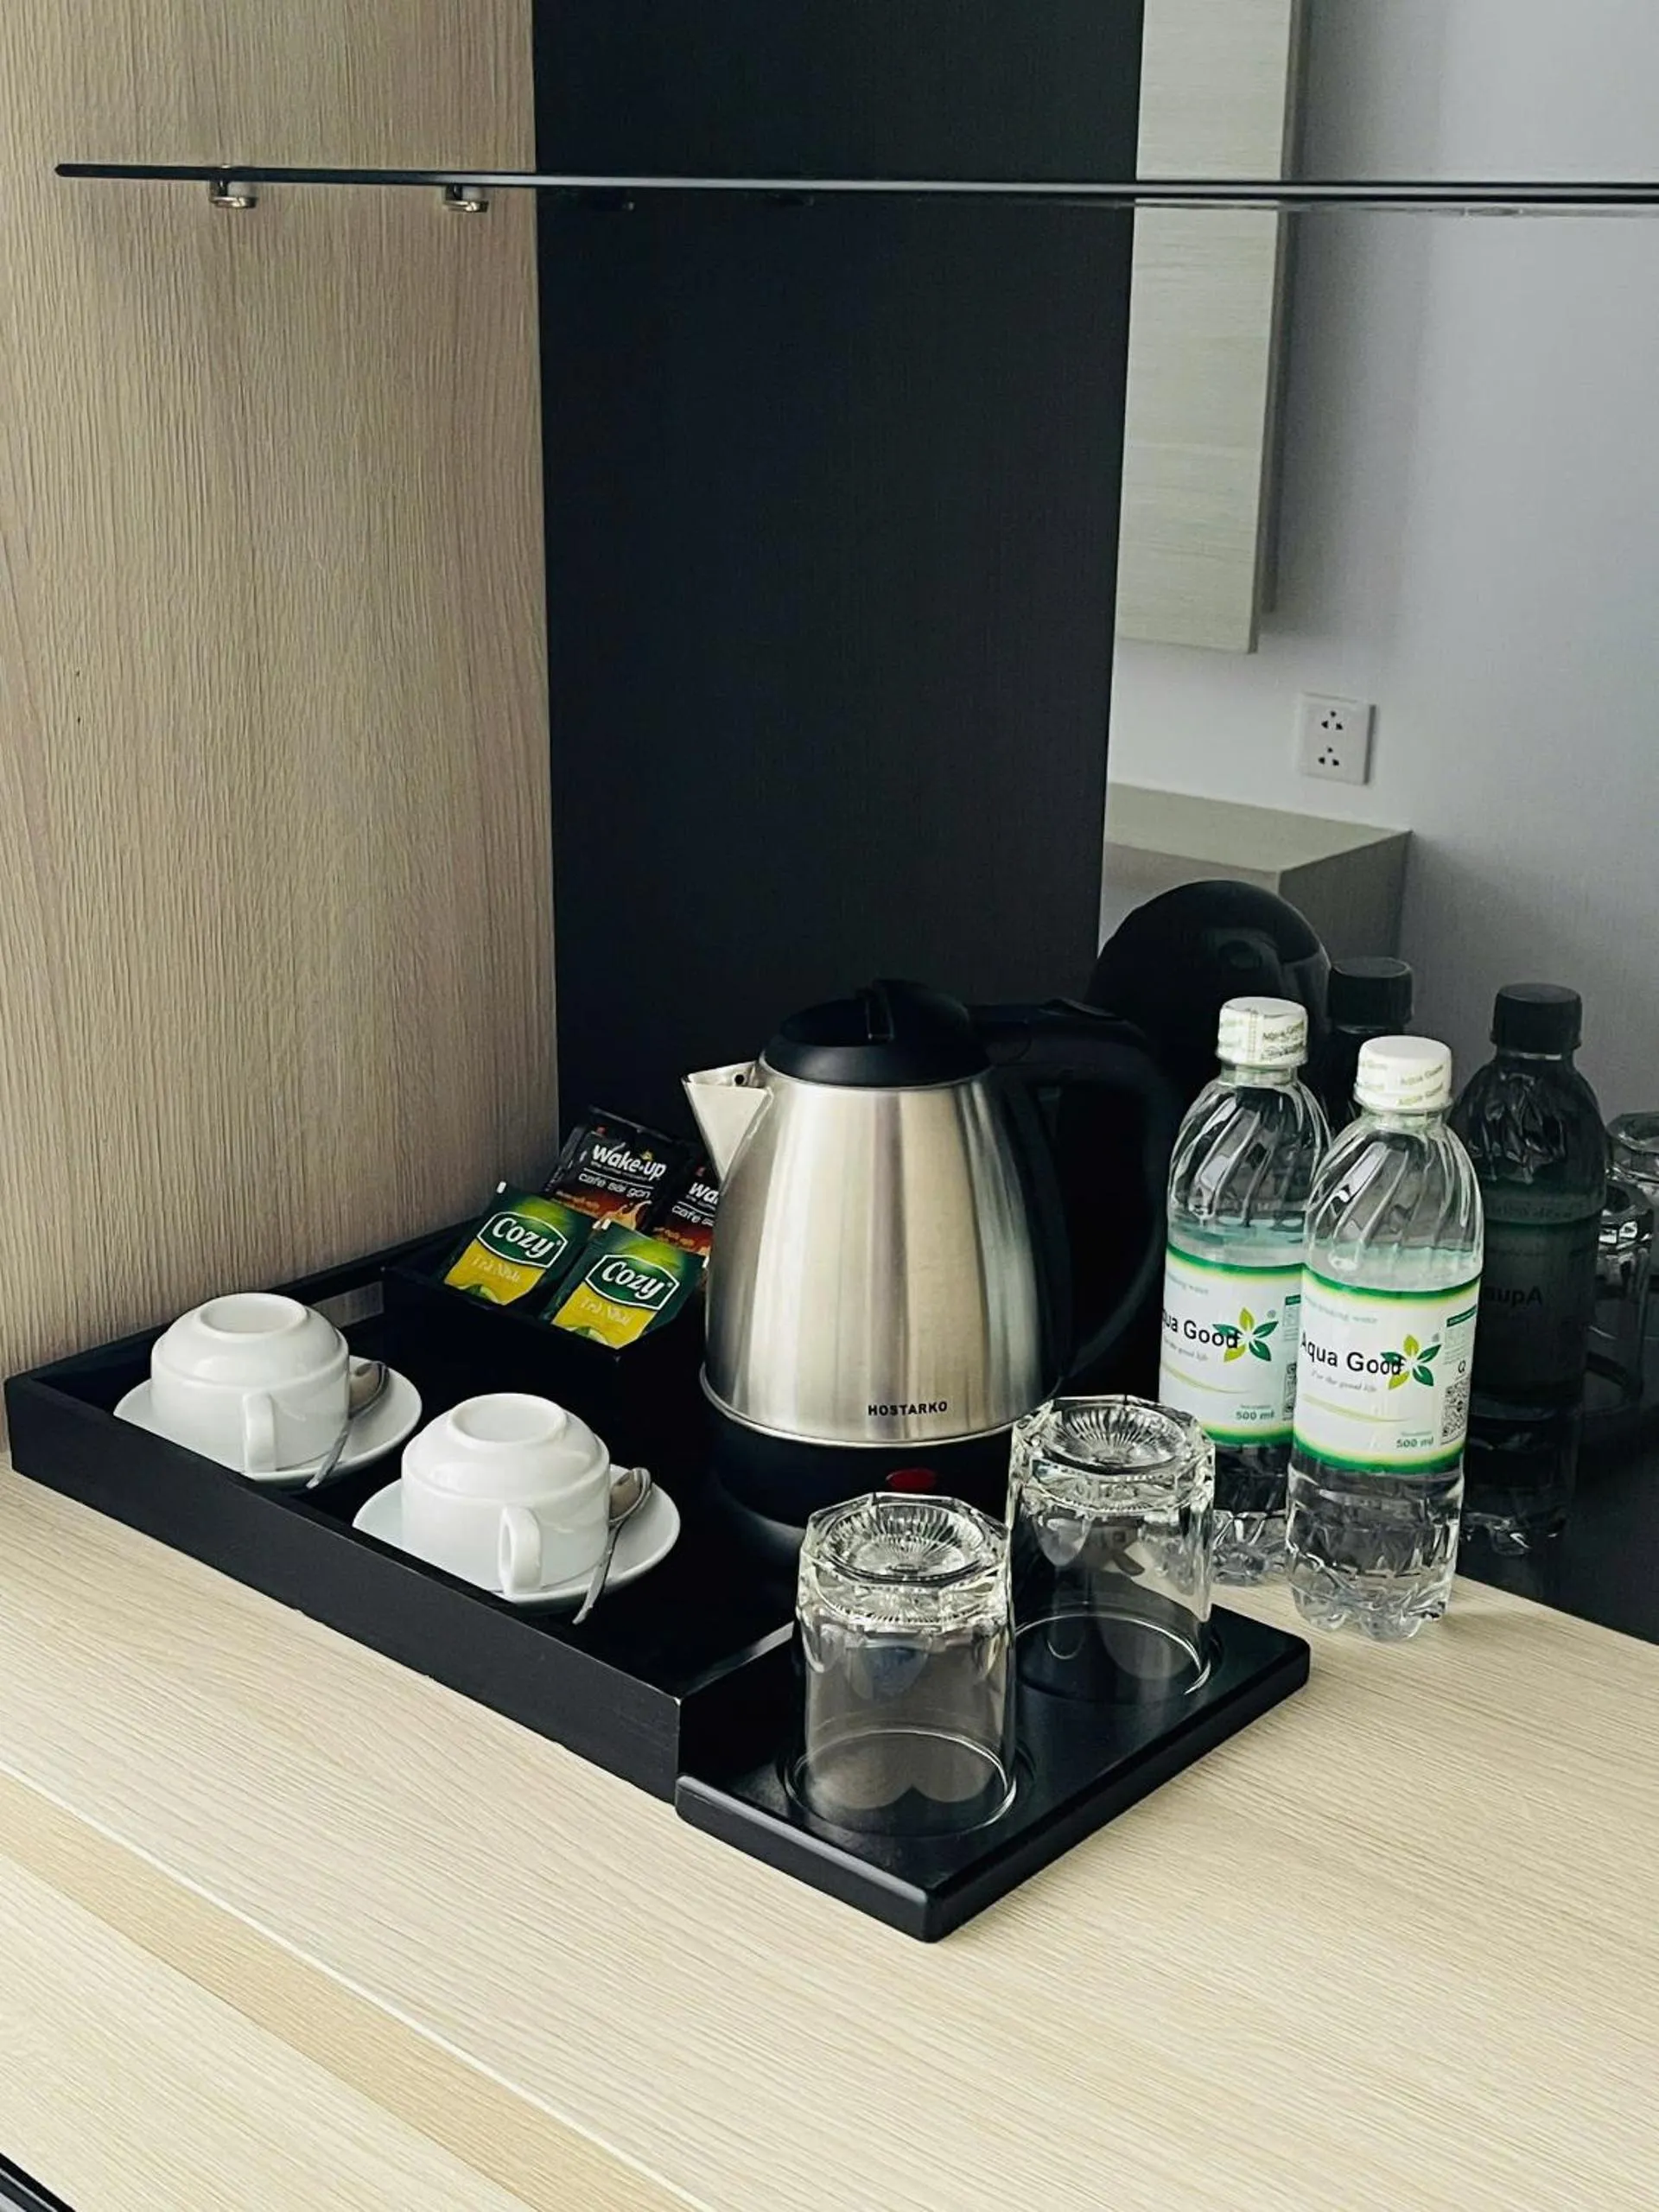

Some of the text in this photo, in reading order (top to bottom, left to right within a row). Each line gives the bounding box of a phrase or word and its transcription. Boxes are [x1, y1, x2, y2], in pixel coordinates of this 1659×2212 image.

[688, 1181, 720, 1205] Wa
[492, 1217, 556, 1258] Cozy
[601, 1262, 665, 1300] Cozy
[1184, 1319, 1239, 1349] Good
[1300, 1331, 1403, 1376] Aqua Good
[868, 1401, 948, 1416] HOSTARKO
[1235, 1410, 1257, 1421] 500
[1395, 1439, 1418, 1448] 500
